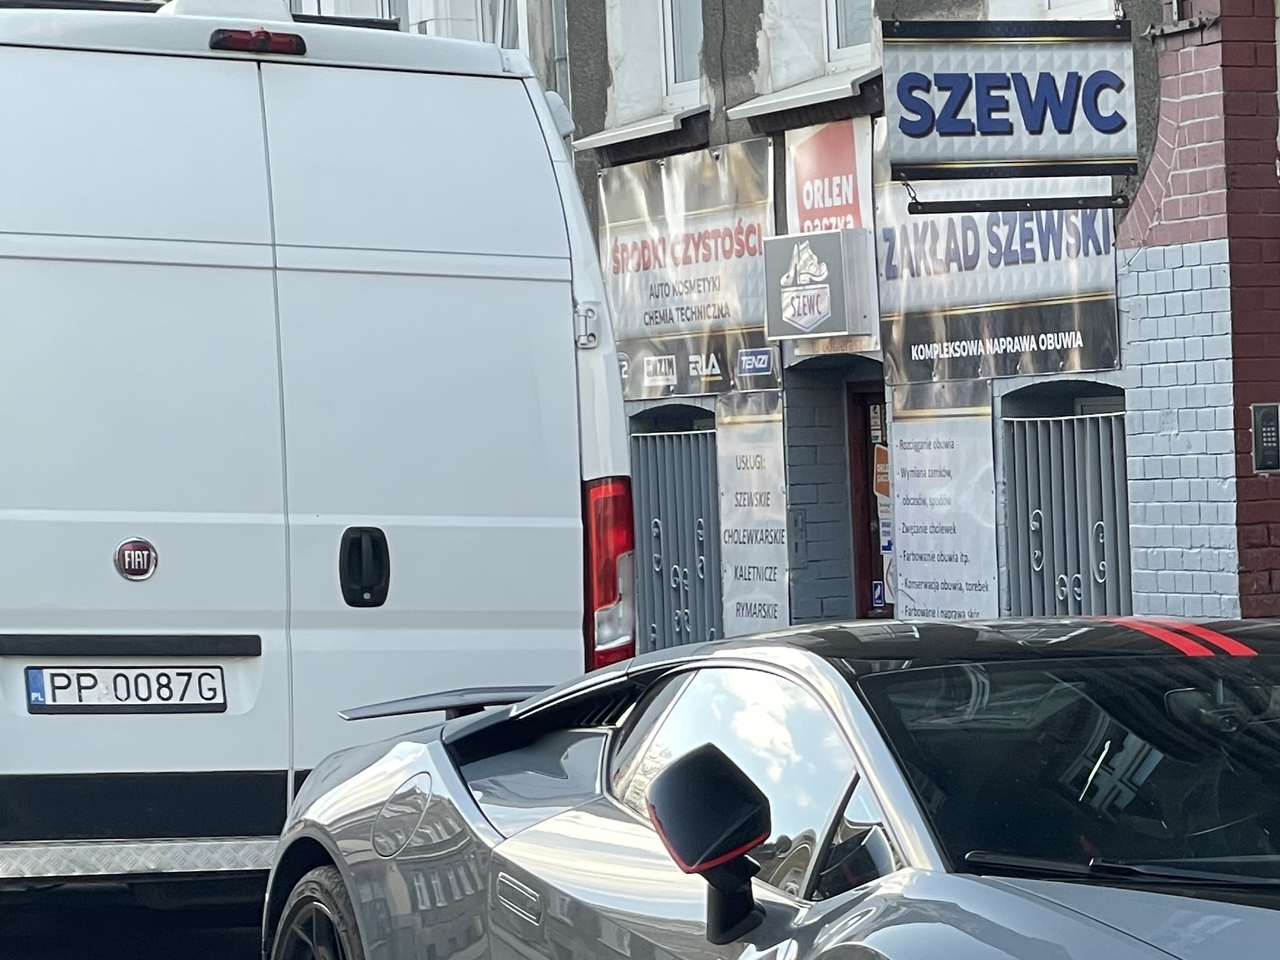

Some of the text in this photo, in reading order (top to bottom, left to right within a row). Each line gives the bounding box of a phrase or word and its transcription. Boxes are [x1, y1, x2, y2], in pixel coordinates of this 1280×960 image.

[896, 69, 1128, 139] SZEWC
[802, 174, 854, 210] ORLEN
[612, 217, 763, 275] ŚRODKI CZYSTOŚCI
[882, 209, 1112, 281] ZAKŁAD SZEWSKI
[650, 275, 721, 300] AUTO KOSMETYKI
[643, 302, 731, 327] CHEMIA TECHNICZNA
[790, 293, 822, 318] SZEWC
[911, 330, 1084, 361] KOMPLEKSOWA NAPRAWA OBUWIA
[741, 354, 769, 370] TENZI
[735, 454, 767, 471] USŁUGI:
[734, 491, 771, 508] SZEWSKIE
[723, 528, 786, 546] CHOLEWKARSKIE
[929, 522, 957, 535] cholewek
[124, 550, 150, 570] FIAT
[937, 550, 959, 563] obuwia
[733, 565, 778, 583] KALETNICZE
[904, 577, 940, 592] Konserwacja
[965, 579, 990, 593] torebek
[735, 601, 778, 620] RYMARSKIE
[49, 672, 218, 703] PP 0087G
[31, 692, 44, 703] PL
